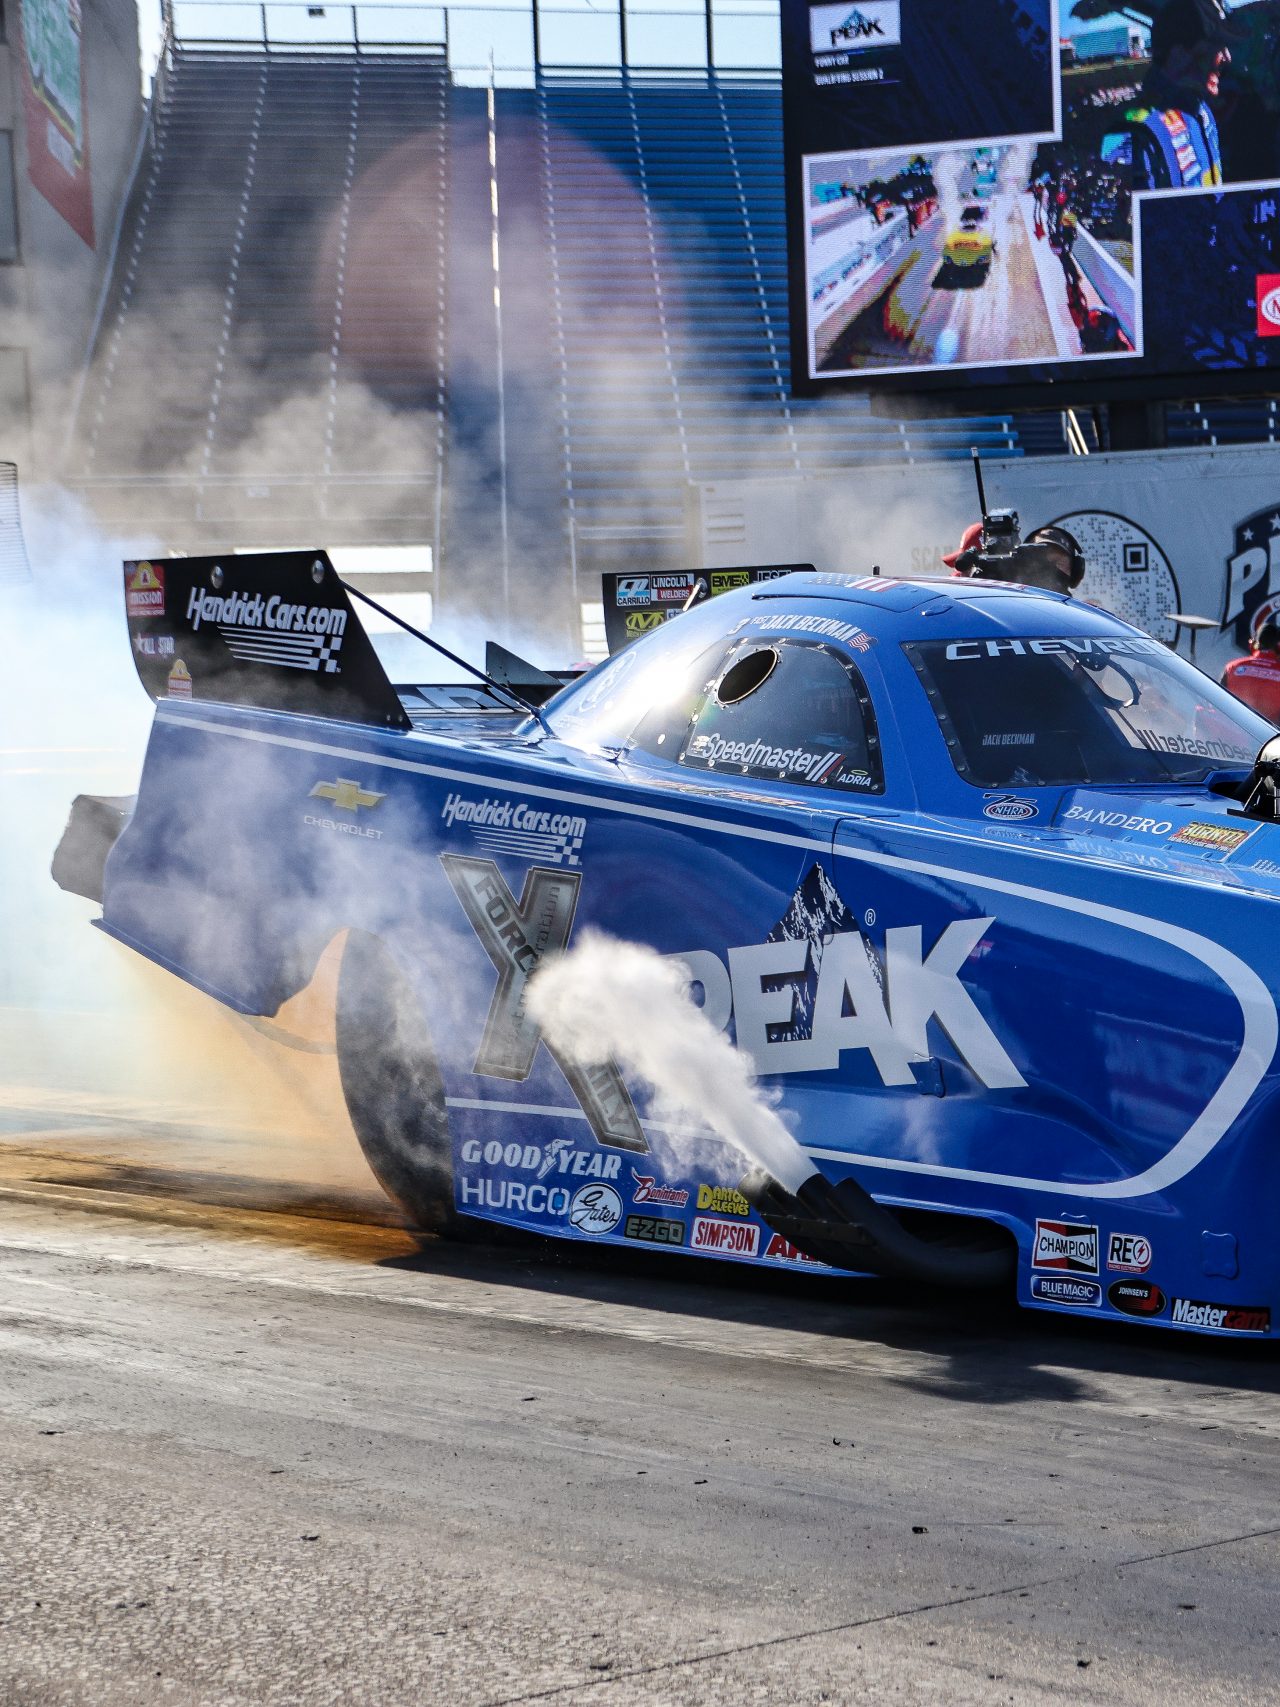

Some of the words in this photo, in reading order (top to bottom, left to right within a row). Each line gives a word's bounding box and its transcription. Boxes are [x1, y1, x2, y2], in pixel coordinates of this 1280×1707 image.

[652, 577, 687, 588] LINCOLN
[660, 589, 690, 599] WELDERS
[186, 586, 347, 635] HendrickCars.com
[617, 596, 650, 605] CARRILLO
[760, 614, 800, 630] JACK
[795, 615, 861, 642] BECKMAN
[982, 734, 1001, 746] JACK
[1002, 733, 1035, 745] BECKMAN
[702, 732, 820, 775] Speedmaster
[837, 773, 872, 786] ADRIA
[441, 793, 587, 838] HendrickCars.com
[994, 806, 1024, 815] NHRA
[1063, 805, 1173, 835] BANDERO
[303, 815, 383, 840] CHEVROLET
[474, 873, 541, 973] FORC
[461, 1177, 571, 1215] HURCO
[570, 1189, 619, 1227] Gates
[710, 1199, 750, 1216] SLEEVES
[695, 1220, 755, 1252] SIMPSON
[1039, 1237, 1094, 1258] CHAMPION
[1118, 1287, 1148, 1298] JOHNSEN'S
[1172, 1298, 1269, 1331] Mastercam
